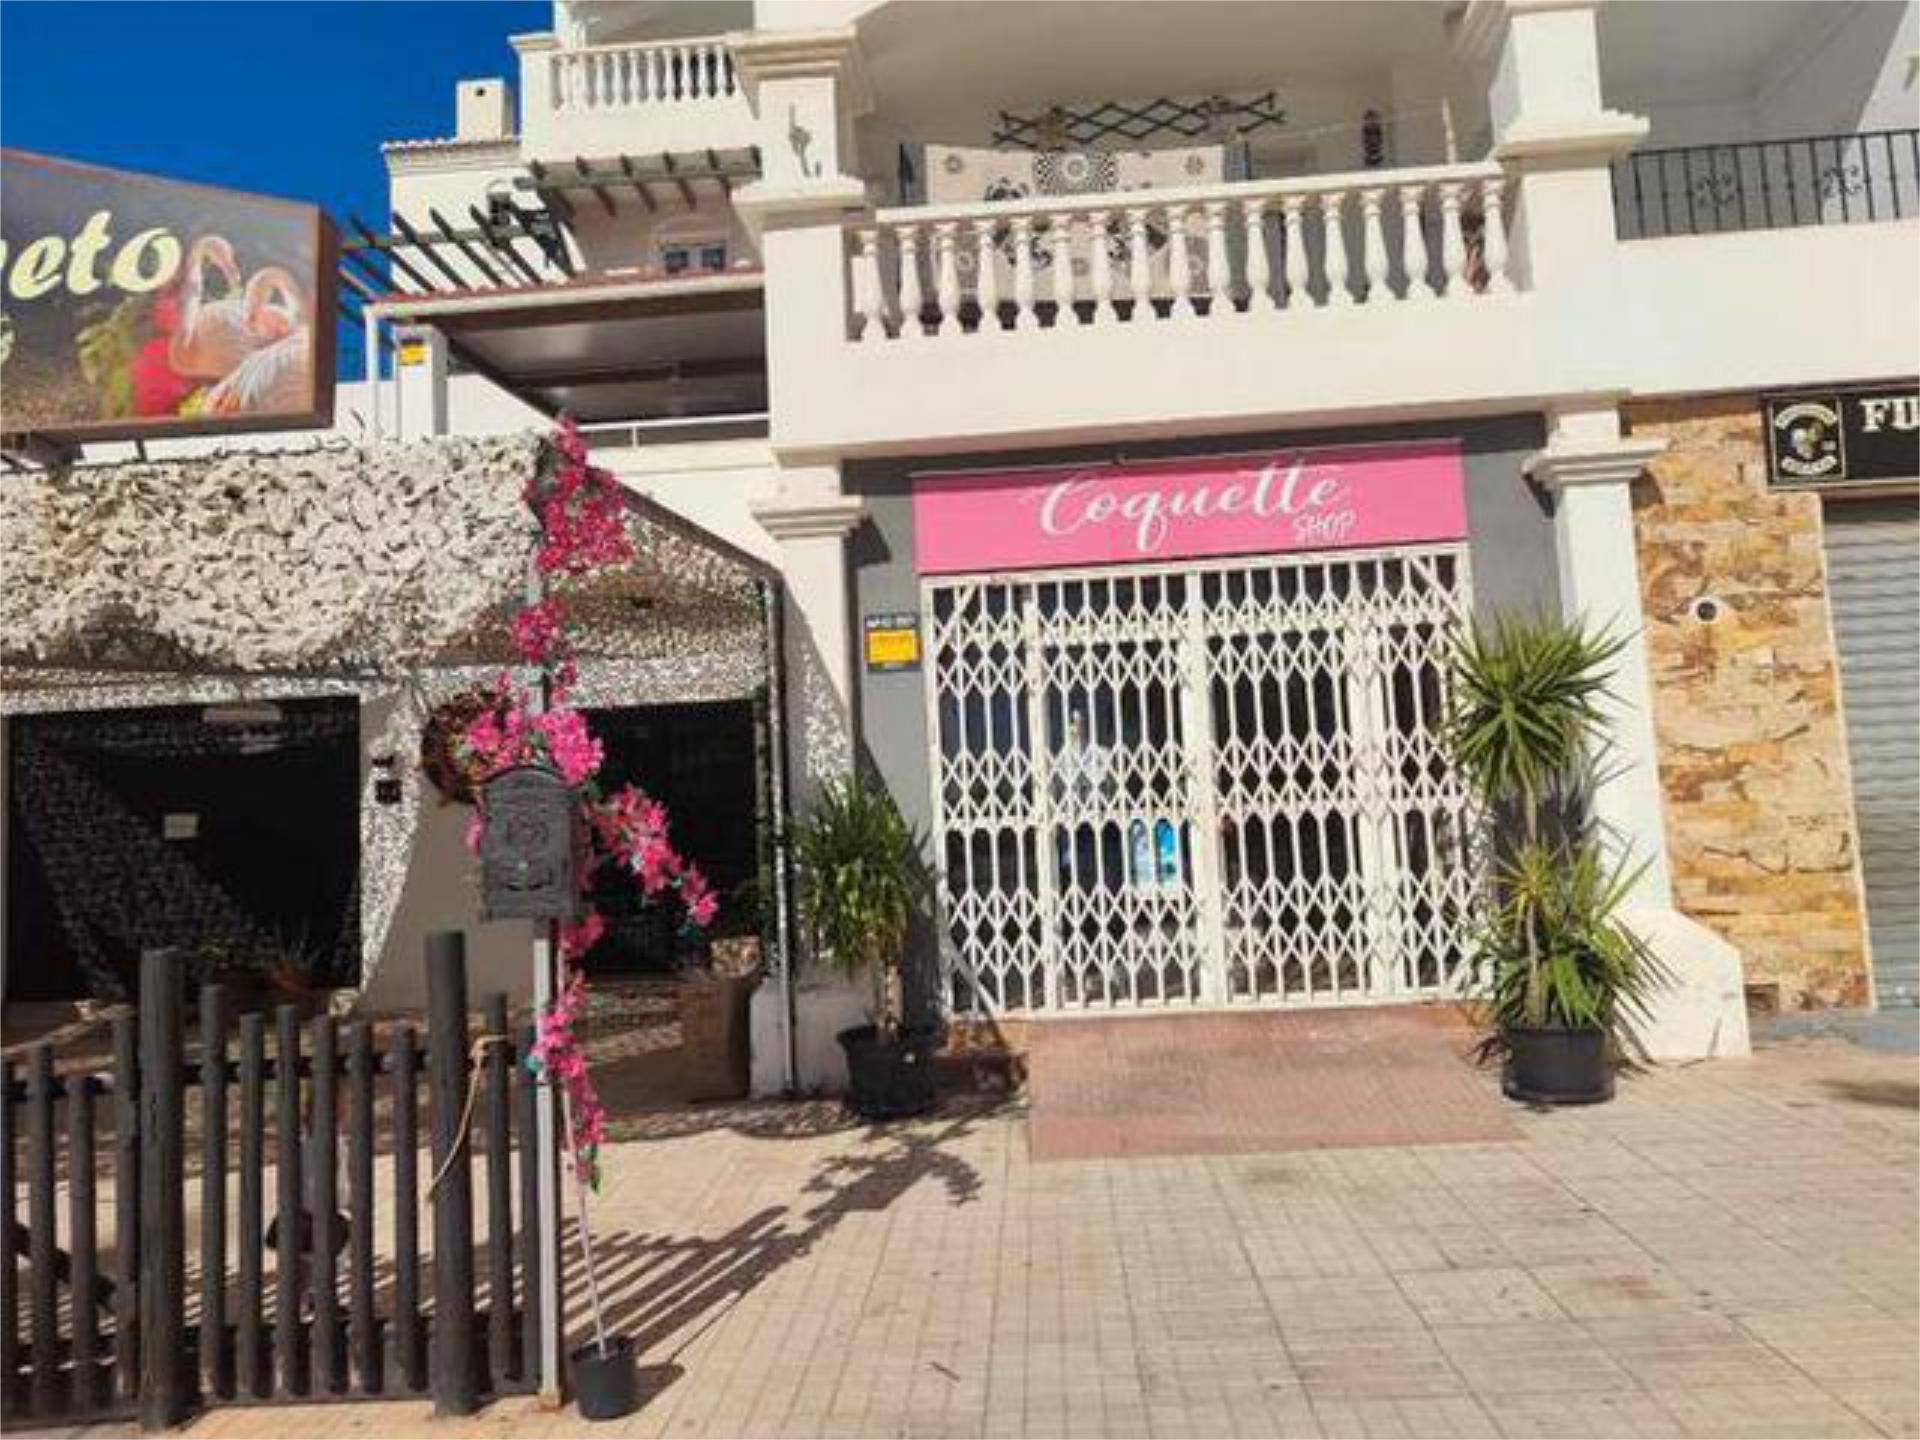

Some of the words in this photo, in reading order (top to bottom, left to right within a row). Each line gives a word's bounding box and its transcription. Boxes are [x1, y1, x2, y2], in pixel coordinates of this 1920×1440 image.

[1, 209, 182, 300] eto
[1022, 461, 1351, 553] Coquette
[1291, 508, 1356, 543] SHOP
